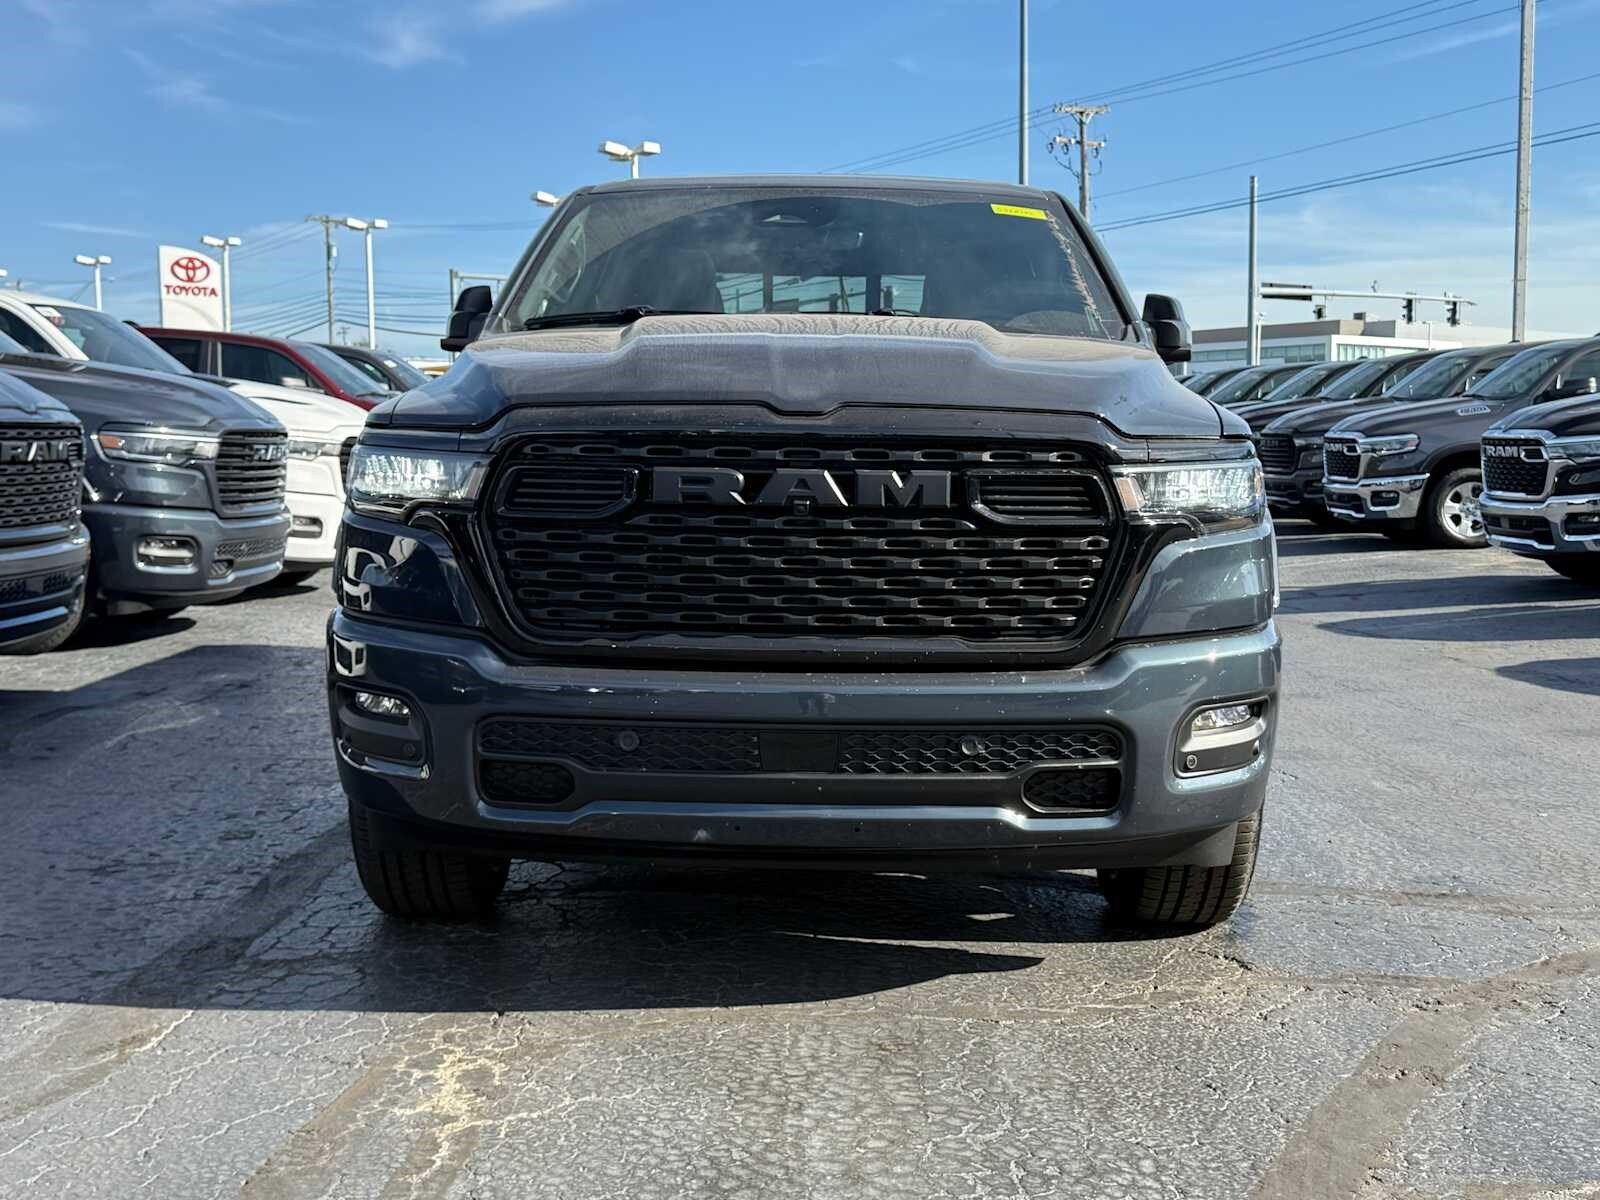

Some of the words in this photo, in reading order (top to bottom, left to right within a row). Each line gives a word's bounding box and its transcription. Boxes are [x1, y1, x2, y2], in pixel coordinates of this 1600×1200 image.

[164, 285, 218, 297] TOYOTA
[1486, 445, 1519, 457] RAM
[652, 467, 952, 507] RAM
